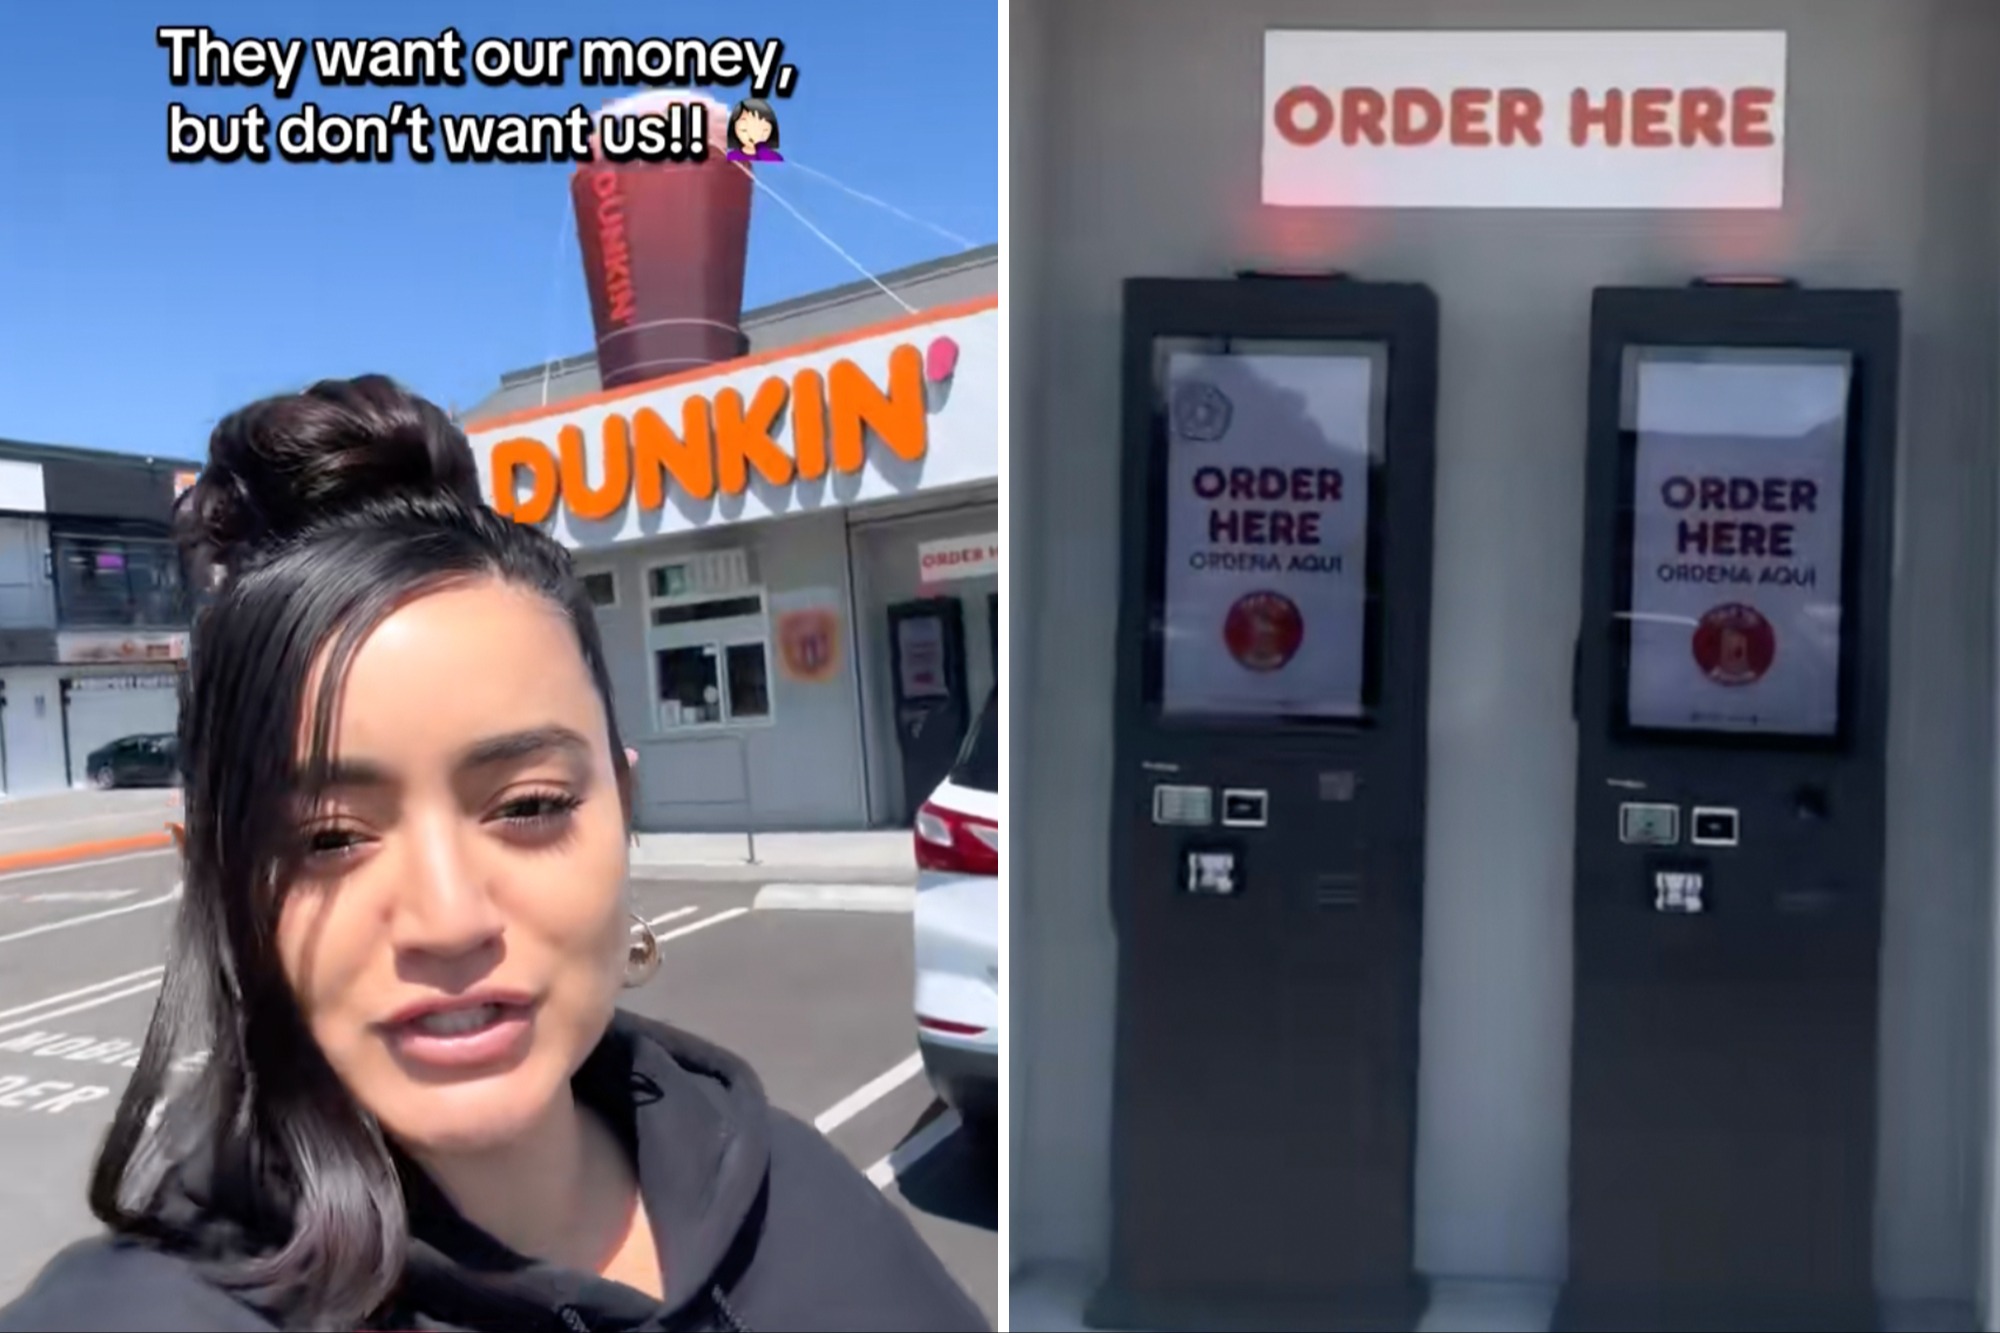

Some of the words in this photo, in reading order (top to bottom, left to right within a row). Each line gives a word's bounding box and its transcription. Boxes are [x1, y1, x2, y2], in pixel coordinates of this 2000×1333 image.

[1273, 85, 1544, 147] ORDER
[1569, 86, 1776, 148] HERE
[490, 335, 959, 524] DUNKIN'
[1192, 466, 1344, 502] ORDER
[1660, 475, 1819, 513] ORDER
[1208, 508, 1322, 545] HERE
[1677, 519, 1795, 558] HERE
